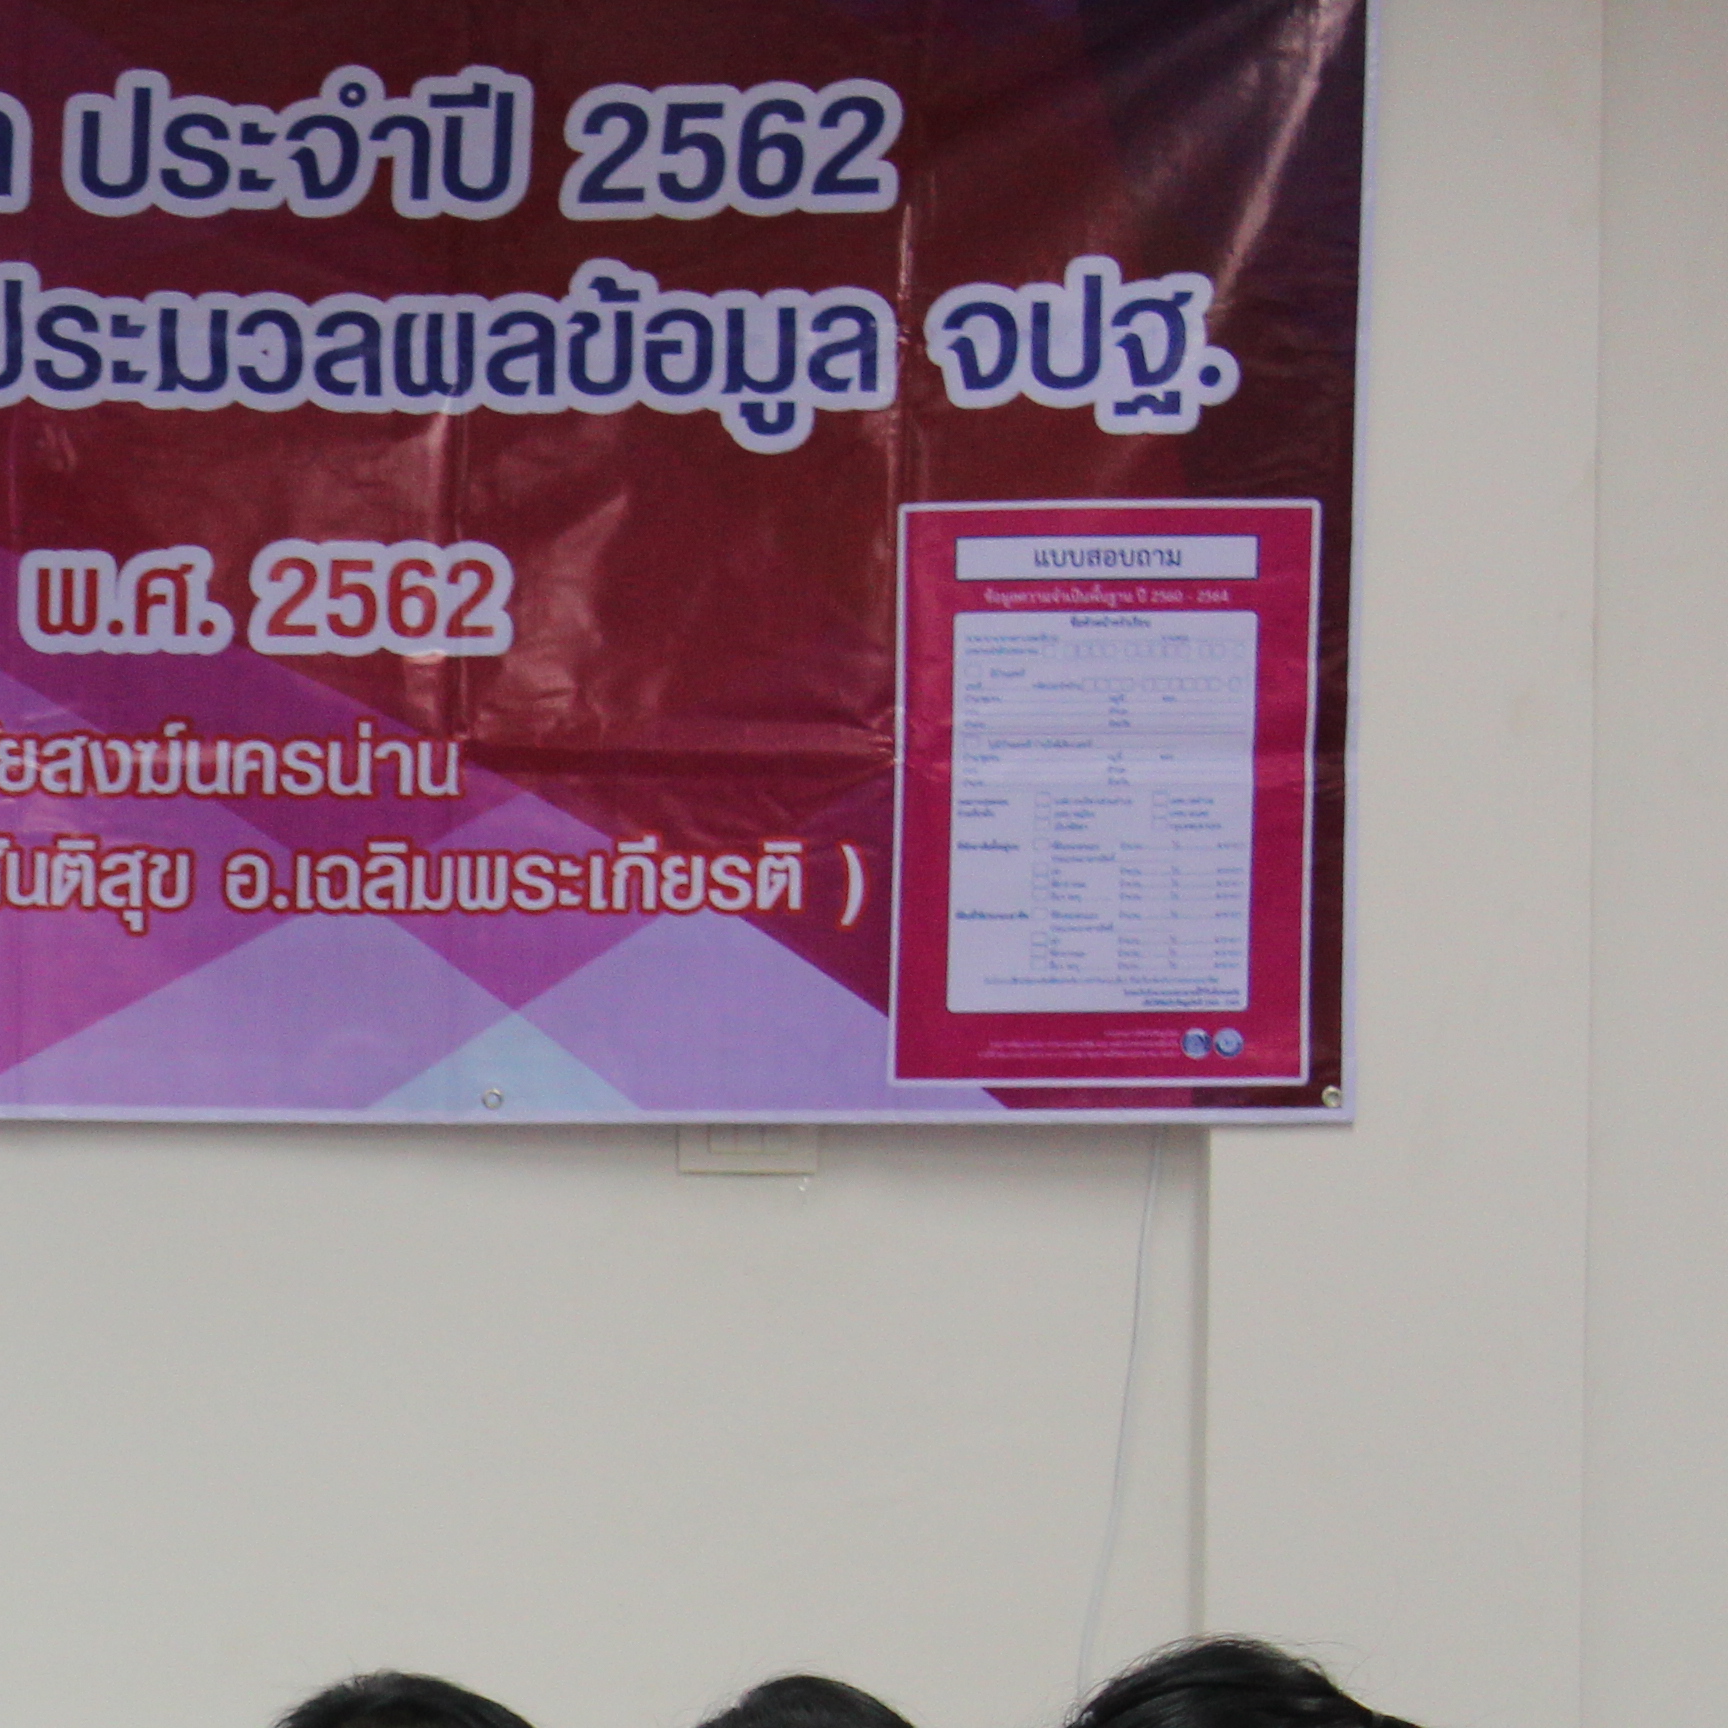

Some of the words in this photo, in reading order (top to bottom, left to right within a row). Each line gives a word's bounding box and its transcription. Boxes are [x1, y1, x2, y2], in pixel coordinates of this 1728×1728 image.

[81, 68, 514, 205] ประจำปี
[579, 96, 886, 206] 2562
[946, 275, 1228, 421] จปฐ.
[264, 557, 498, 639] 2562
[1033, 545, 1182, 569] แบบสอบถาม
[223, 834, 806, 916] อ.เฉลิมพระเกียรติ
